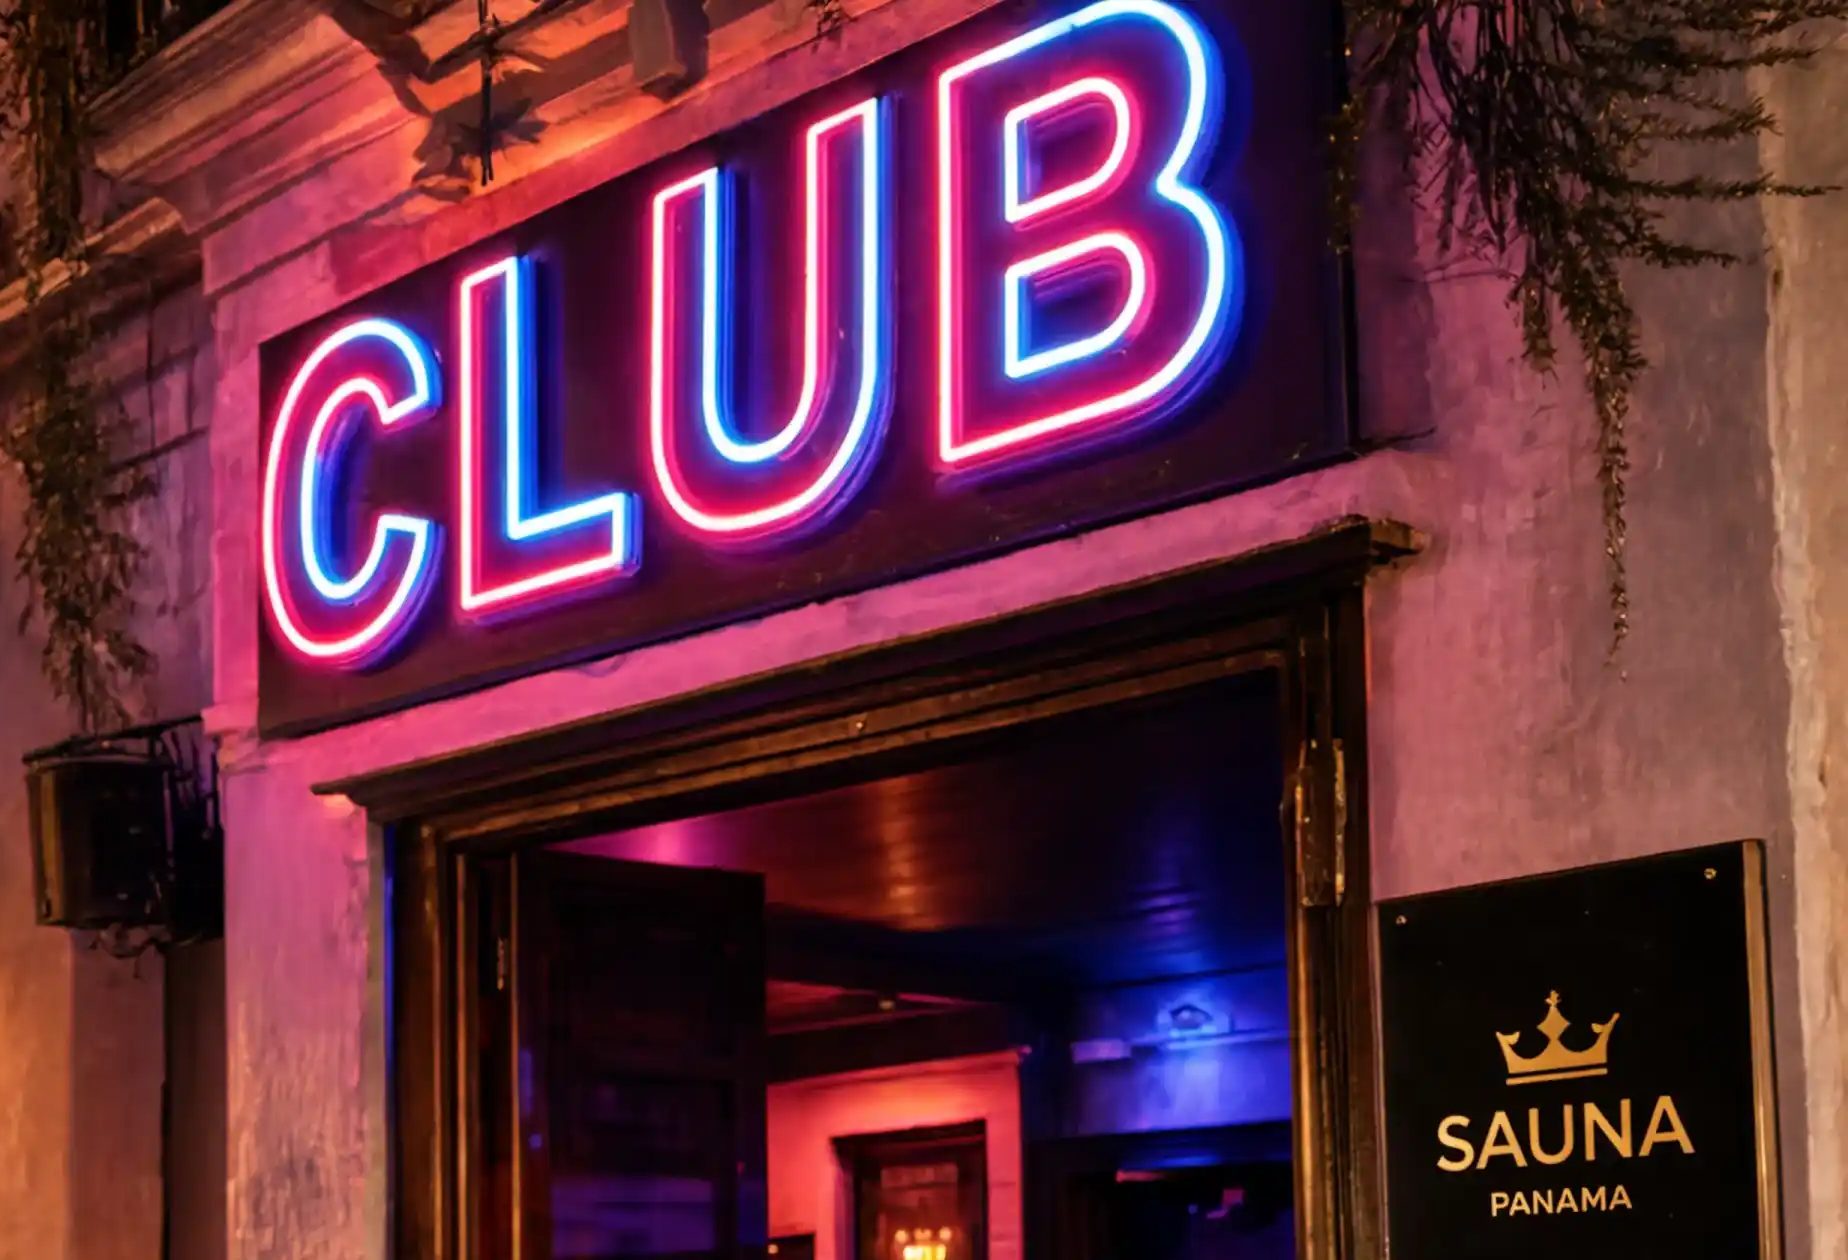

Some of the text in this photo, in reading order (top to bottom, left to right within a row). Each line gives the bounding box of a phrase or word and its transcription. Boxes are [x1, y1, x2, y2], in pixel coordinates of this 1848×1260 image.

[263, 0, 1230, 661] CLUB
[1437, 1095, 1695, 1171] SAUNA
[1491, 1185, 1633, 1216] PANAMA
